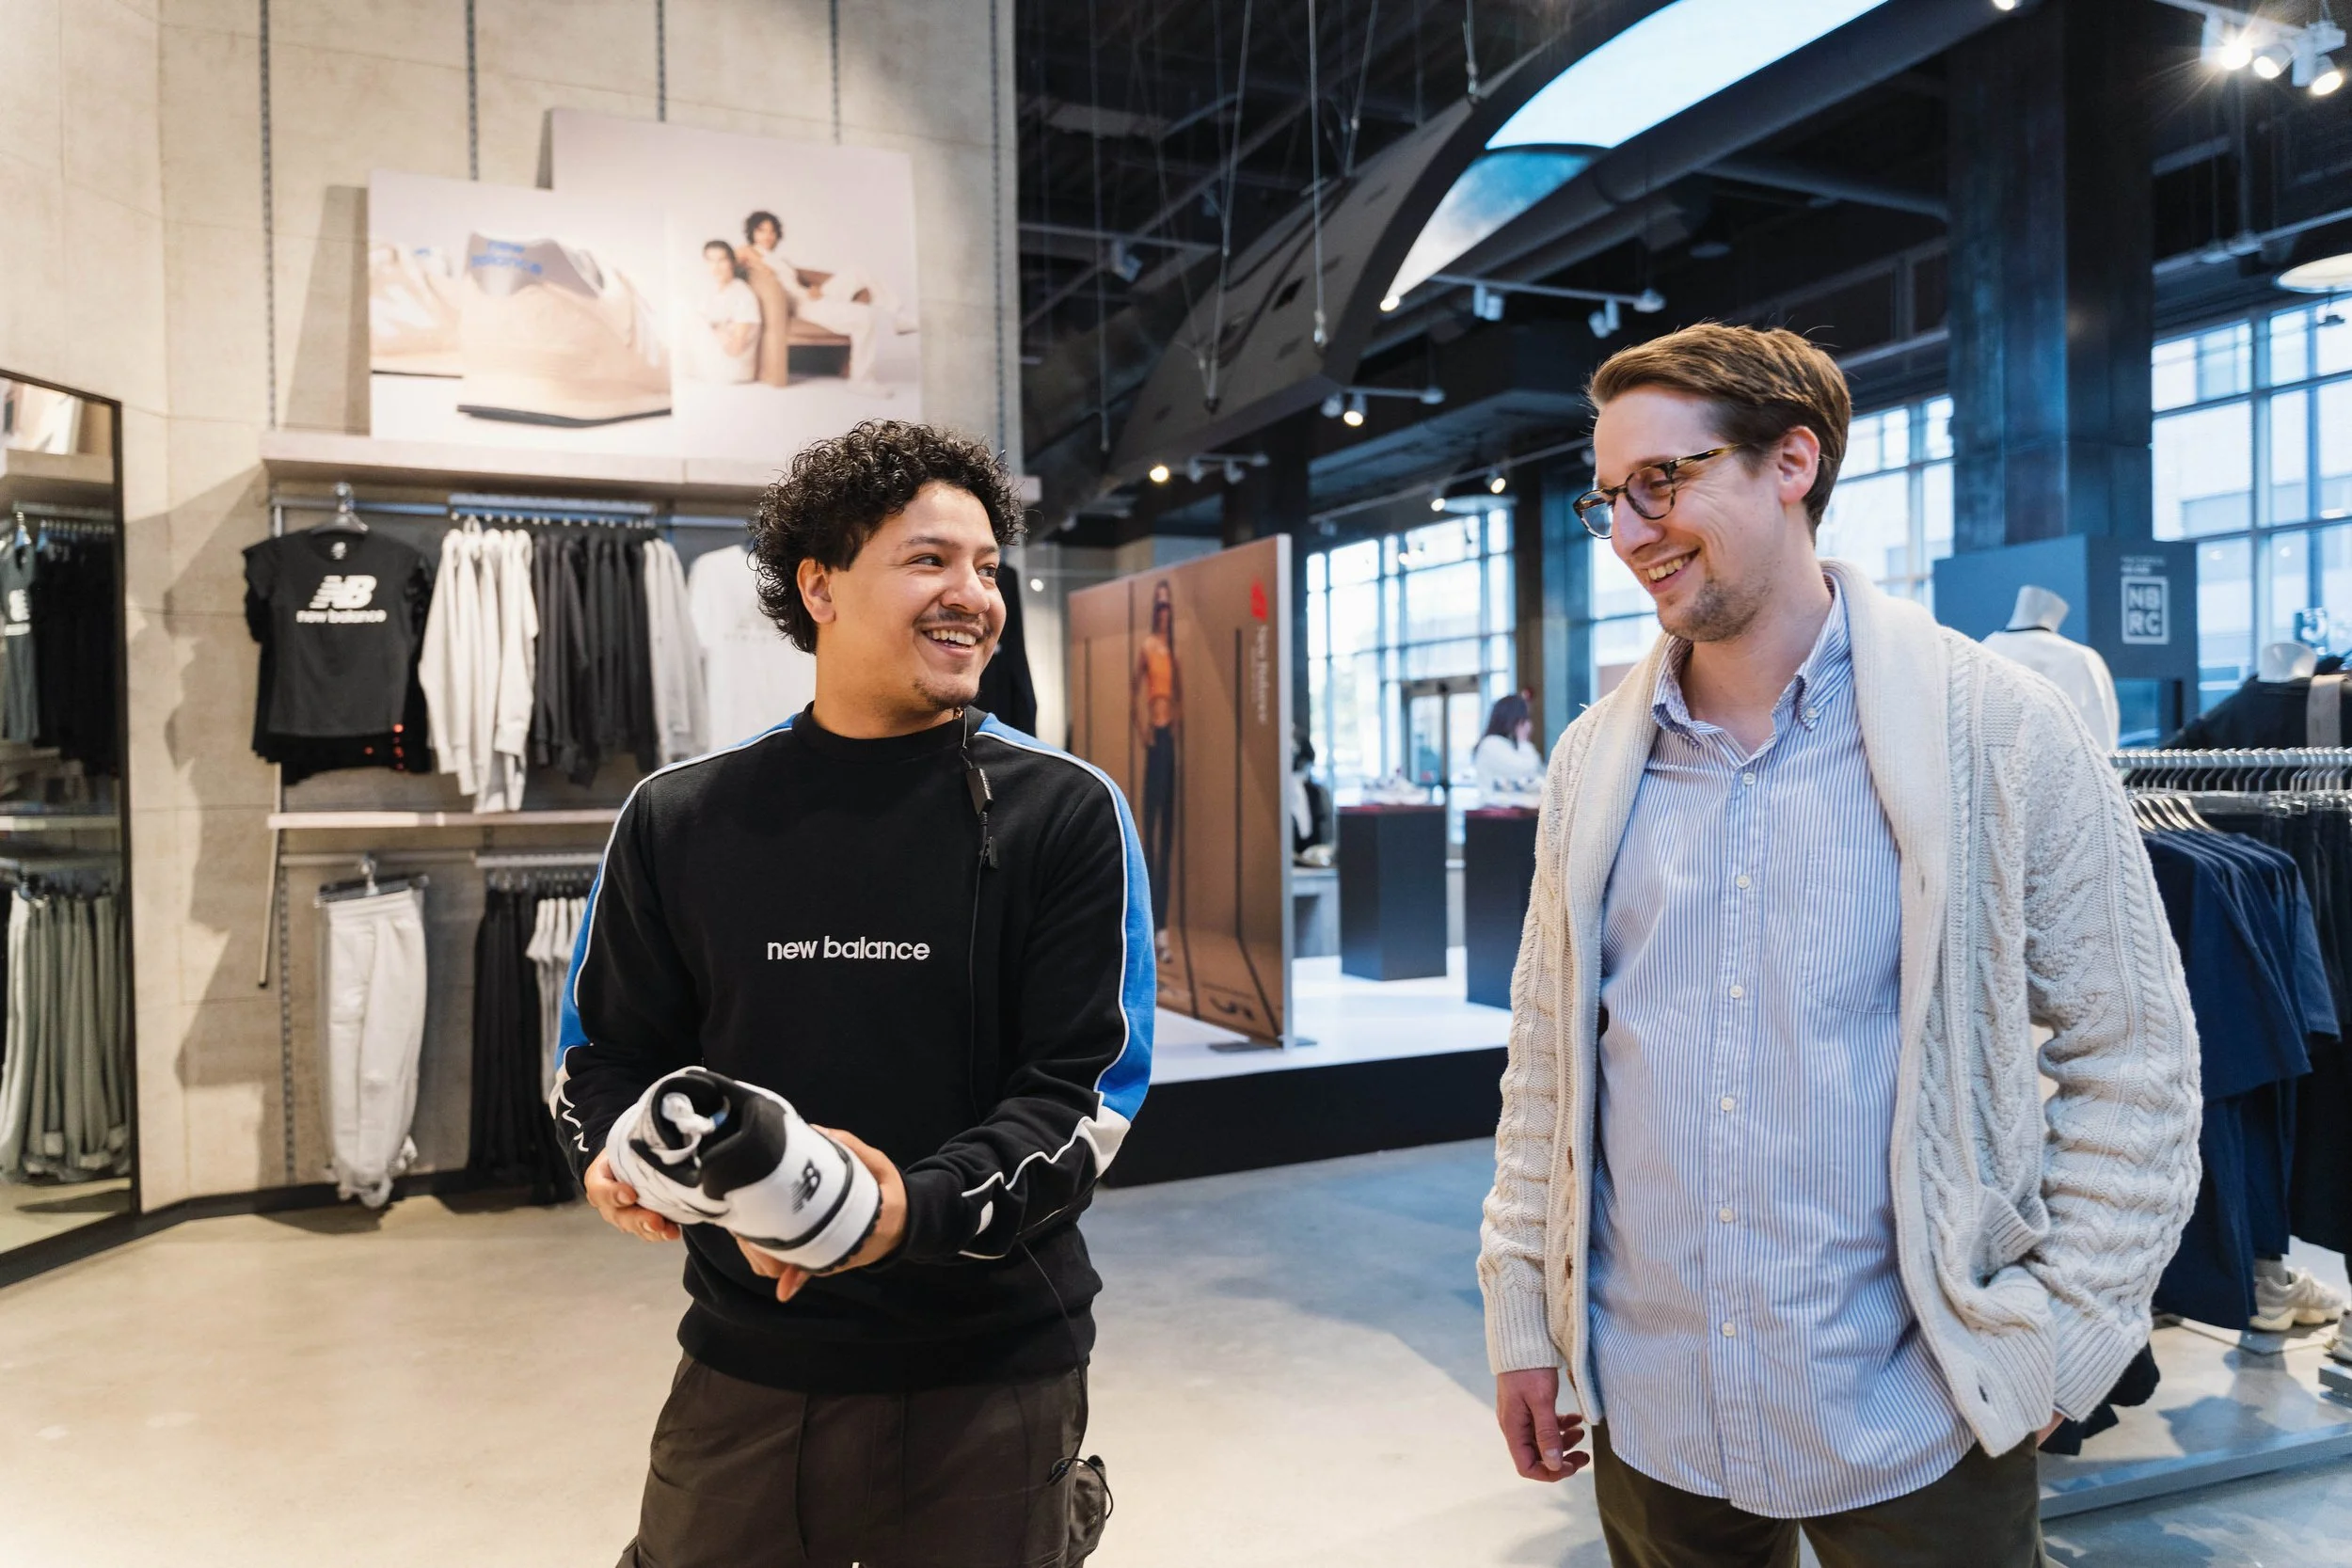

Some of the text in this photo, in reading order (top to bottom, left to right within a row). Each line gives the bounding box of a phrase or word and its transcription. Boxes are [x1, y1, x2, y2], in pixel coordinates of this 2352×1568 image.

[309, 575, 377, 610] NB
[2128, 585, 2162, 610] NB
[767, 935, 931, 961] new balance
